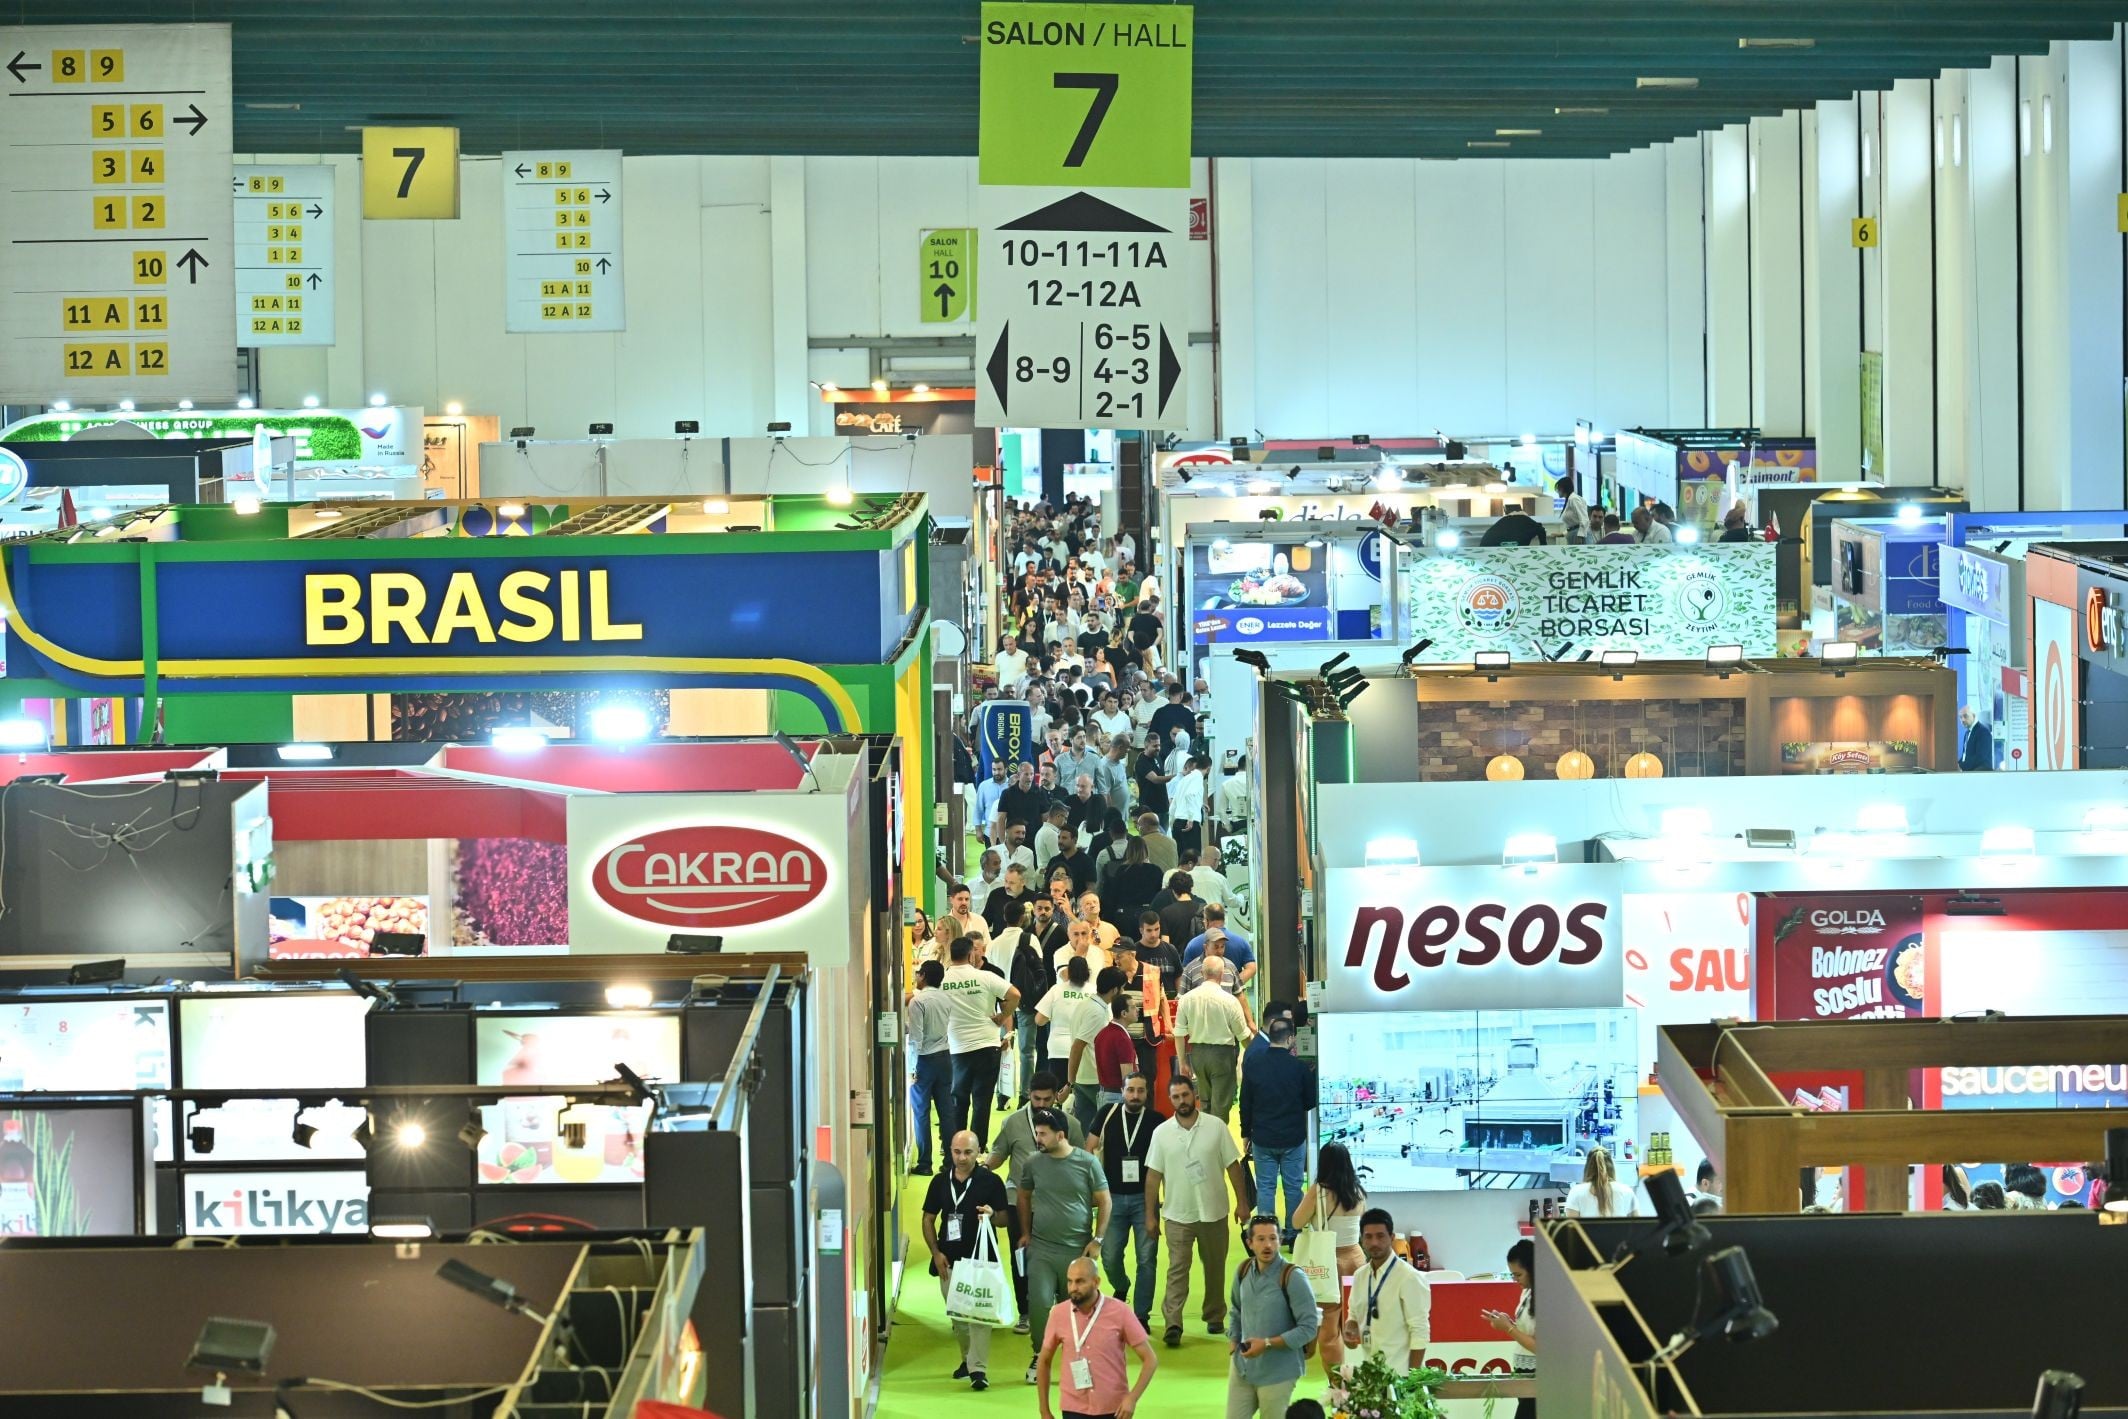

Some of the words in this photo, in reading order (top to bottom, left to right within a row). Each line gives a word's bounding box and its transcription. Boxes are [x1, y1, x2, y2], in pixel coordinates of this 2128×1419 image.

[986, 20, 1085, 46] SALON
[1092, 22, 1106, 47] /
[1114, 23, 1187, 48] HALL
[61, 56, 76, 77] 8
[100, 55, 115, 77] 9
[102, 111, 115, 132] 5
[139, 110, 154, 131] 6
[1053, 72, 1119, 168] 7
[102, 157, 116, 178] 3
[140, 156, 155, 176] 4
[392, 147, 425, 199] 7
[540, 165, 549, 176] 8
[559, 165, 567, 176] 9
[253, 179, 261, 190] 8
[271, 179, 279, 190] 9
[560, 191, 567, 202] 5
[578, 191, 586, 202] 6
[104, 203, 116, 223] 1
[141, 202, 155, 222] 2
[272, 206, 279, 217] 5
[290, 206, 298, 217] 6
[560, 213, 568, 224] 3
[578, 213, 586, 224] 4
[272, 228, 279, 239] 3
[290, 228, 298, 239] 4
[561, 235, 567, 246] 1
[579, 235, 586, 246] 2
[930, 238, 958, 246] SALON
[1858, 223, 1869, 242] 6
[272, 250, 279, 260] 1
[290, 250, 297, 261] 2
[933, 249, 954, 257] HALL
[1002, 239, 1168, 269] 10-11-11A
[137, 257, 163, 278] 10
[577, 262, 590, 272] 10
[929, 260, 959, 279] 10
[287, 276, 301, 287] 10
[543, 284, 555, 295] 11
[561, 284, 569, 294] A
[577, 283, 590, 294] 11
[254, 298, 266, 309] 11
[271, 298, 280, 309] A
[287, 299, 300, 309] 11
[1027, 279, 1142, 308] 12-12A
[67, 304, 92, 324] 11
[104, 303, 121, 324] A
[138, 303, 163, 323] 11
[543, 306, 556, 317] 12
[561, 305, 570, 317] A
[578, 305, 590, 316] 12
[254, 320, 266, 331] 12
[271, 320, 280, 331] A
[287, 320, 300, 331] 12
[1094, 323, 1151, 351] 6-5
[68, 350, 93, 370] 12
[105, 349, 122, 369] A
[139, 349, 165, 369] 12
[1015, 355, 1071, 384] 8-9
[1093, 357, 1149, 385] 4-3
[1095, 391, 1143, 419] 2-1
[173, 420, 213, 430] GROUP
[1549, 566, 1642, 590] GEMLİK
[305, 569, 643, 645] BRASIL
[1543, 589, 1648, 613] TİCARET
[1907, 600, 1931, 609] Food
[1540, 618, 1650, 637] BORSASI
[997, 712, 1005, 740] ORIGINAL
[1008, 713, 1021, 760] BROX
[607, 844, 813, 895] CAKRAN
[1810, 909, 1887, 927] GOLDA
[1343, 902, 1608, 992] nesos
[1669, 947, 1750, 992] SAU
[1811, 945, 1888, 979] Bolonez
[942, 979, 981, 991] BRASIL
[1813, 976, 1883, 1016] soslu
[22, 1006, 31, 1017] 7
[58, 1020, 69, 1033] 8
[195, 1189, 371, 1237] kilikya
[955, 1281, 994, 1299] BRASIL
